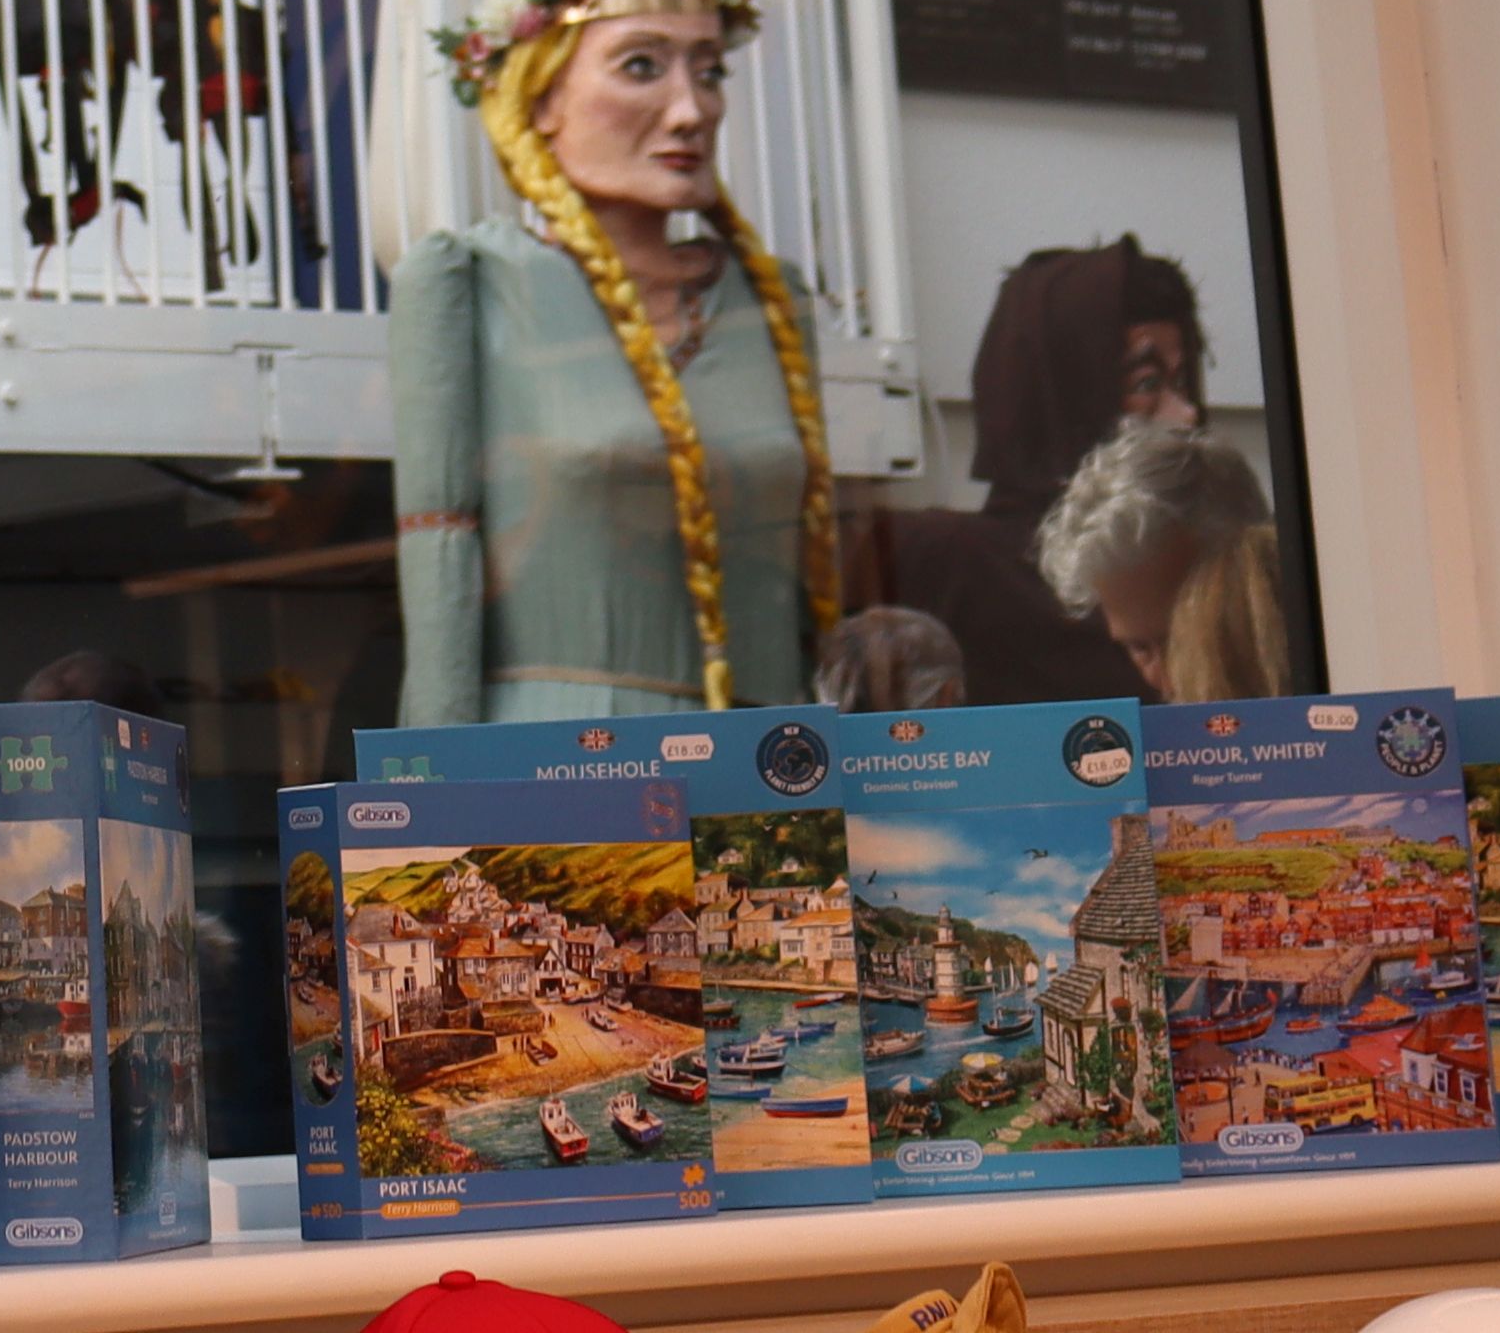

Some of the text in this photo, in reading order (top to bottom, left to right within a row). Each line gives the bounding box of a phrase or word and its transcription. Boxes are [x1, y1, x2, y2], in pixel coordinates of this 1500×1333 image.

[667, 744, 710, 757] £18.00
[1252, 741, 1327, 762] WHITBY
[1380, 742, 1407, 775] PEOPLE
[1419, 740, 1444, 773] PLANET
[6, 756, 47, 772] 1000
[536, 759, 660, 780] MOUSEHOLE
[841, 750, 992, 774] GHTHOUSE BAY
[863, 779, 958, 794] Dominic Davison
[1191, 771, 1263, 787] Roger Turner
[352, 807, 405, 823] Gibsons
[3, 1130, 78, 1147] PADSTOW
[310, 1125, 335, 1140] PORT
[1225, 1131, 1297, 1148] Gibsons
[309, 1141, 338, 1156] ISAAC
[902, 1147, 975, 1167] Gibsons
[4, 1151, 79, 1168] HARBOUR
[7, 1176, 78, 1191] Terry Harrison
[380, 1178, 468, 1198] PORT ISAAC
[386, 1200, 457, 1216] Terry Harrison
[678, 1190, 712, 1210] 500
[321, 1203, 343, 1219] 500
[11, 1223, 77, 1240] Gibsons
